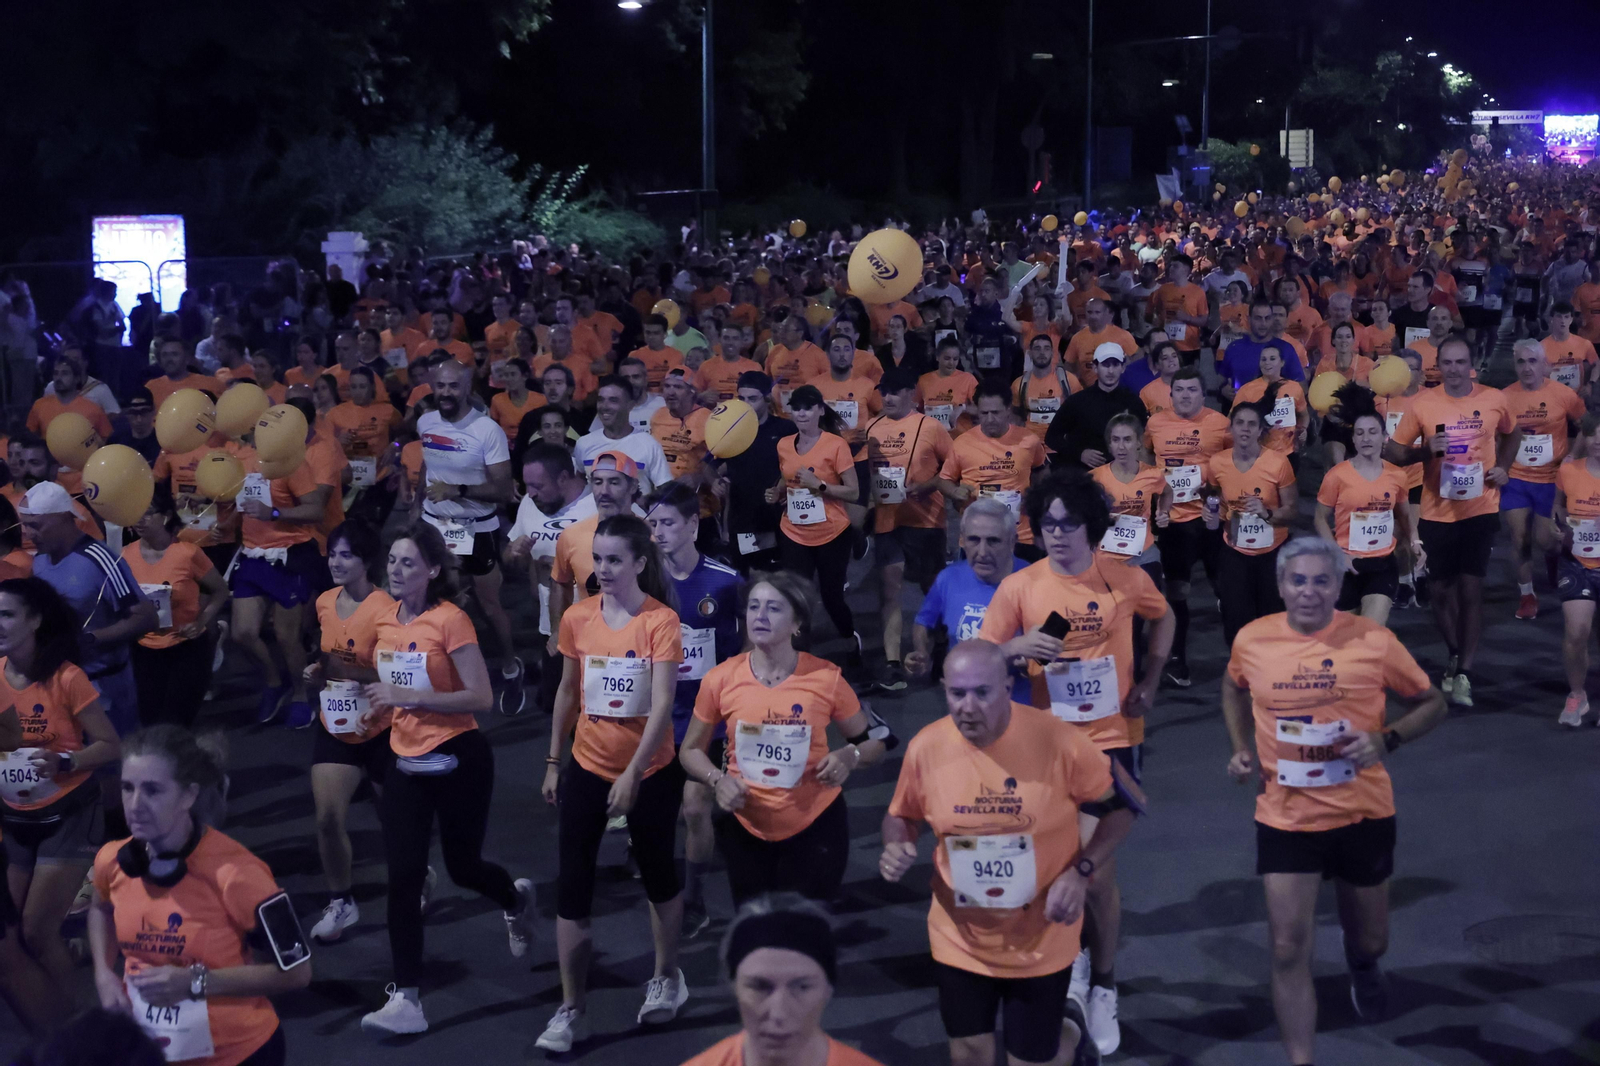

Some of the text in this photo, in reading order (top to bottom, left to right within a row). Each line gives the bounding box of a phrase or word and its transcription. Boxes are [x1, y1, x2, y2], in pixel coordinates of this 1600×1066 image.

[1524, 445, 1544, 454] 4450
[876, 479, 898, 489] 18263
[1171, 478, 1191, 489] 3490
[1452, 476, 1475, 486] 3683
[792, 500, 816, 510] 18264
[443, 529, 465, 540] 4809
[1114, 527, 1136, 539] 5629
[1239, 524, 1264, 534] 14791
[1361, 524, 1388, 536] 14750
[1578, 531, 1600, 542] 3682
[1067, 617, 1103, 625] OCTURNA
[682, 646, 704, 659] 041
[391, 671, 413, 686] 5837
[602, 677, 634, 692] 7962
[1066, 680, 1102, 697] 9122
[1271, 682, 1311, 690] SEVILLA
[327, 699, 358, 712] 20851
[20, 718, 48, 726] CTURNA
[756, 743, 792, 762] 7963
[1, 768, 41, 784] 15043
[974, 796, 1023, 804] NOCTURNA
[953, 804, 997, 814] SEVILLA
[973, 860, 1014, 878] 9420
[135, 932, 186, 944] NOCTURNA
